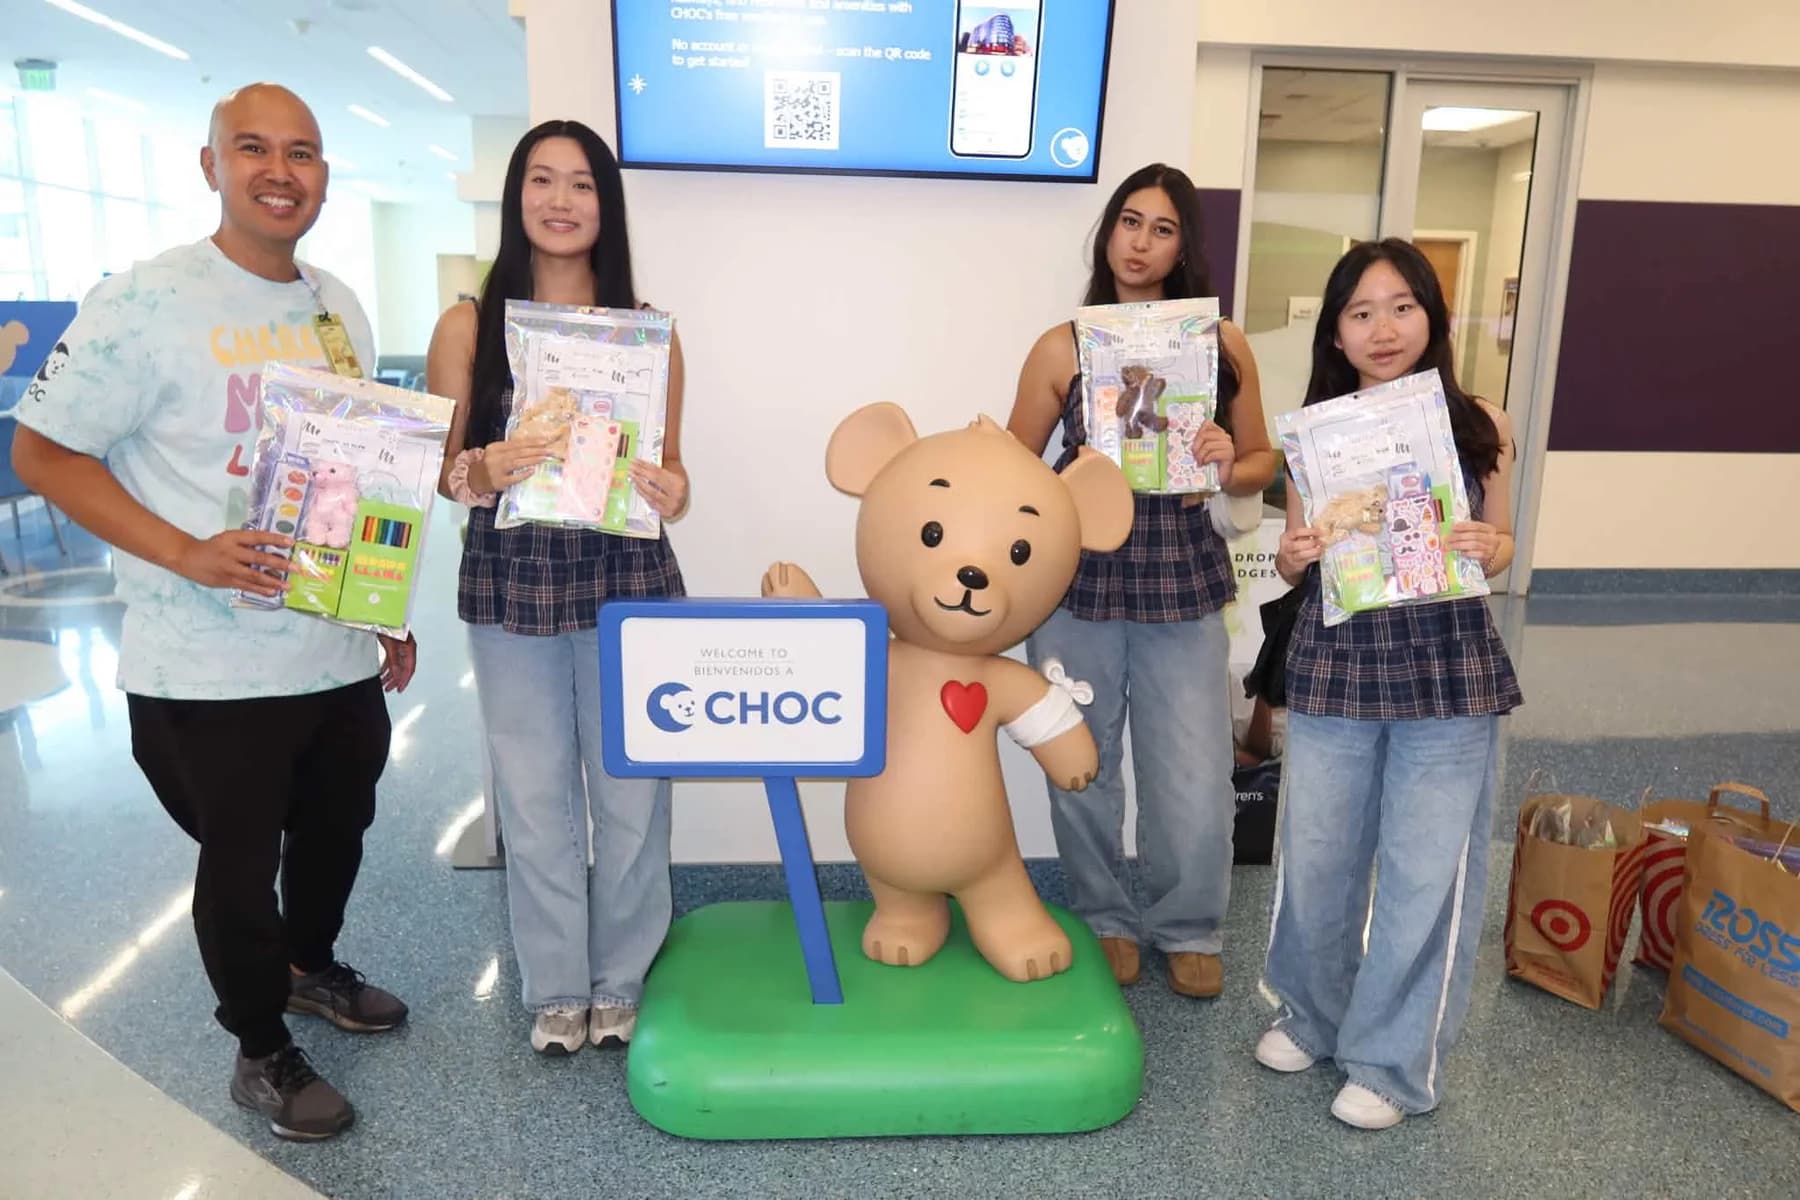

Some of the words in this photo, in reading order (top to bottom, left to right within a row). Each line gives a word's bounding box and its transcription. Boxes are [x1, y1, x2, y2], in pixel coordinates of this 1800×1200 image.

[671, 7, 713, 20] CHOC's
[889, 3, 913, 14] with
[672, 38, 688, 51] No
[691, 41, 735, 52] account
[836, 47, 861, 57] scan
[864, 46, 882, 58] the
[885, 47, 902, 60] QR
[904, 48, 932, 61] code
[672, 55, 684, 66] to
[687, 56, 705, 69] get
[1235, 553, 1276, 562] DROP
[1238, 569, 1277, 578] DGES
[700, 648, 764, 658] WELCOME
[771, 648, 788, 658] TO
[694, 666, 780, 676] BIENVENIDOS
[785, 667, 794, 676] A
[704, 691, 843, 725] CHOC
[1701, 888, 1800, 972] ROSS
